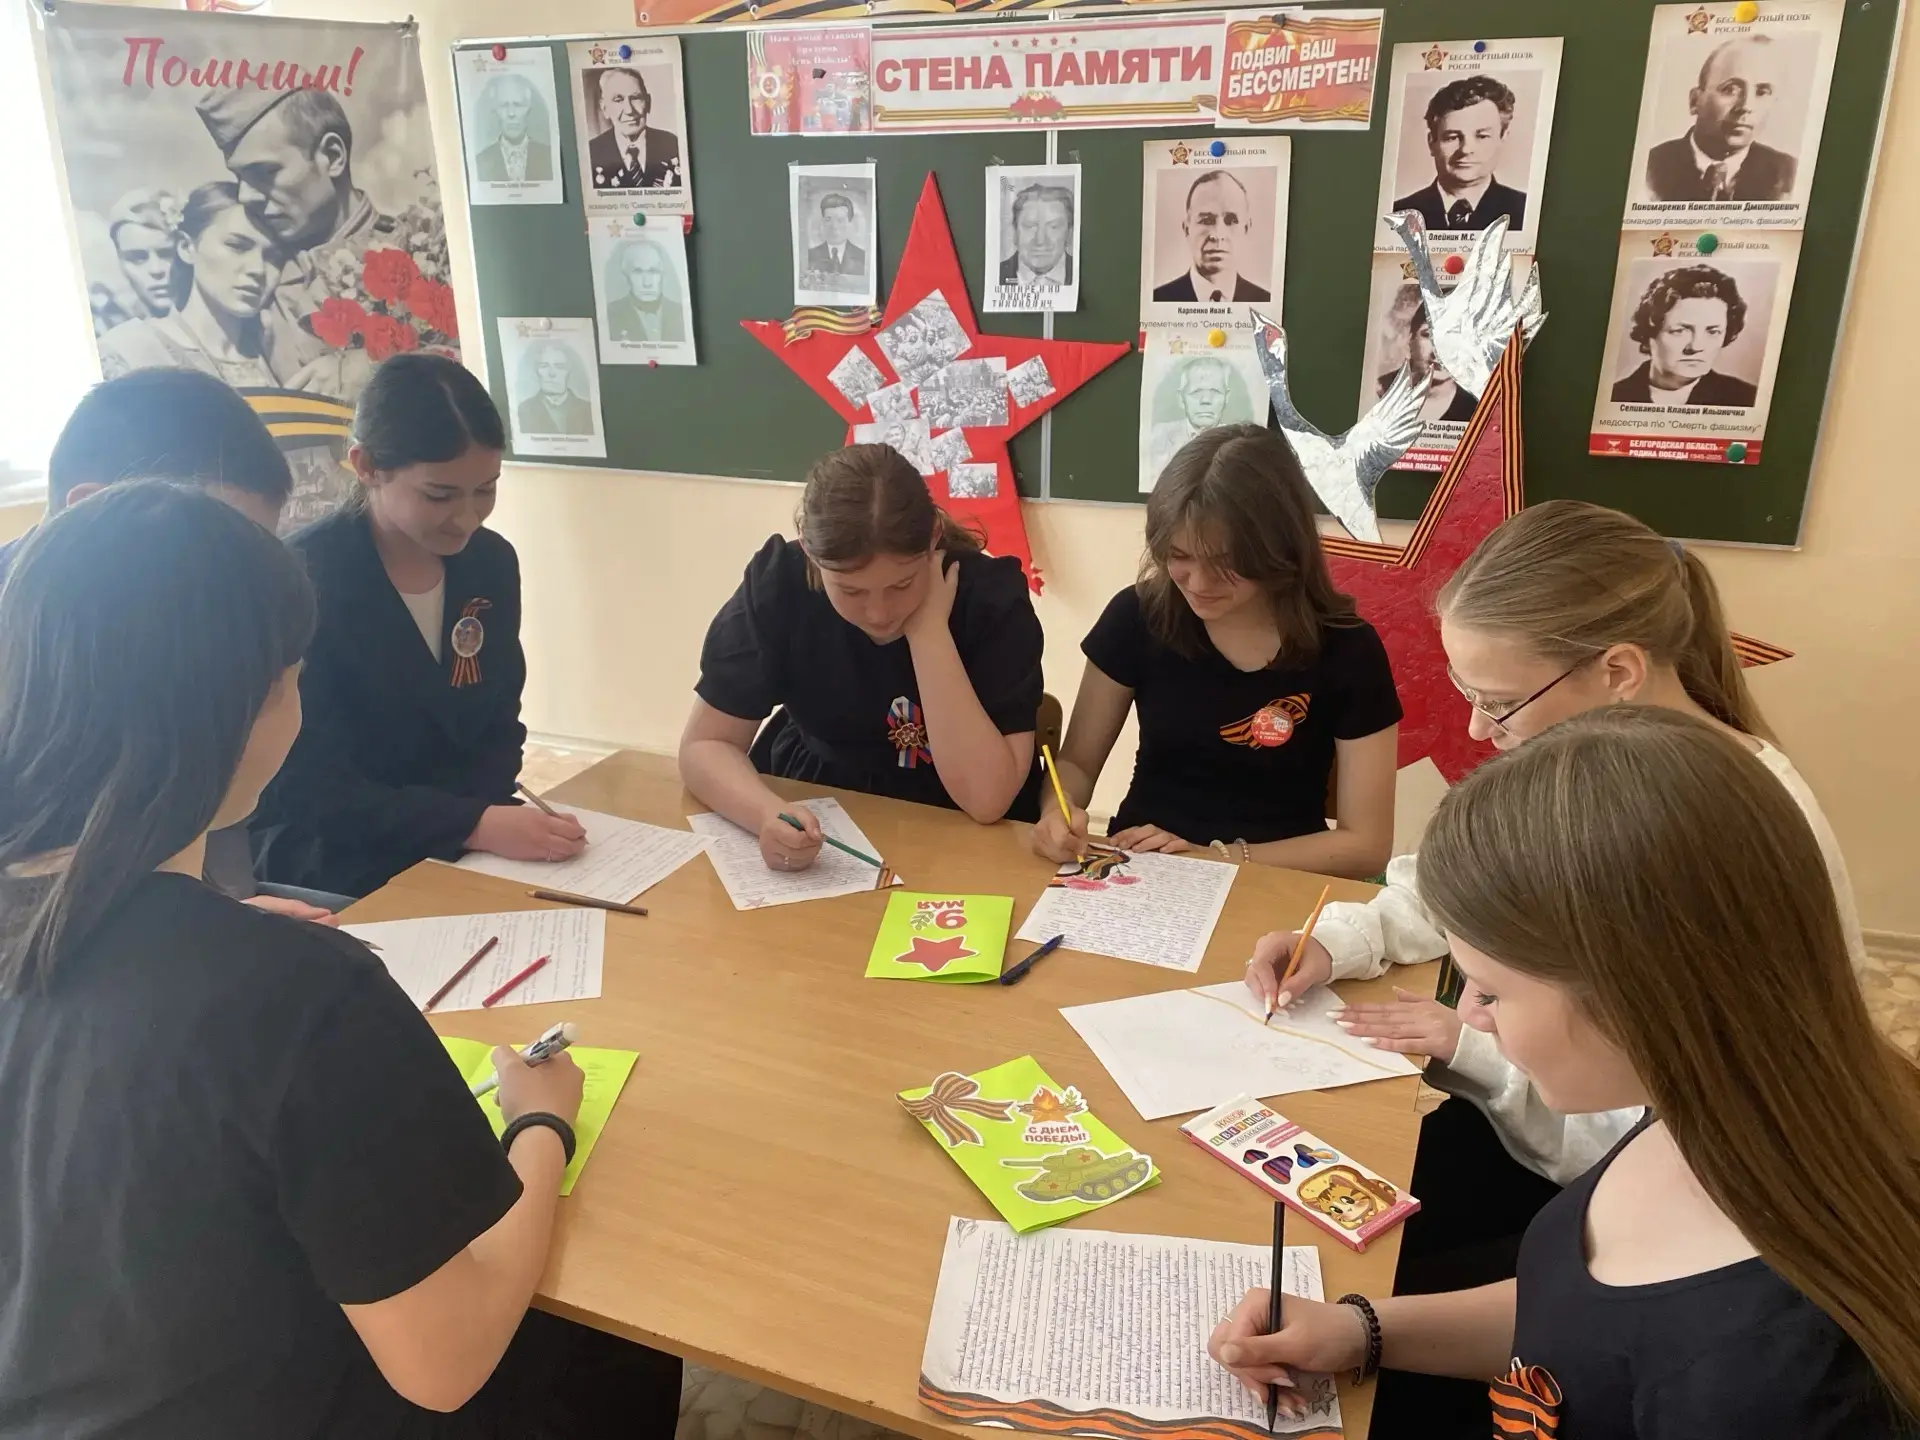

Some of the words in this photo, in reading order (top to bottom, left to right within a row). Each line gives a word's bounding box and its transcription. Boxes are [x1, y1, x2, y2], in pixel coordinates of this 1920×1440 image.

[1230, 44, 1296, 71] ПОДВИГ
[1300, 38, 1336, 62] ВАШ
[1449, 52, 1510, 60] БЕССМЕРТНЫЙ
[123, 37, 364, 97] Помним!
[876, 55, 1013, 92] СТЕНА
[1025, 45, 1212, 87] ПАМЯТИ
[1228, 56, 1371, 98] БЕССМЕРТЕН!
[1631, 203, 1687, 211] Пономаренко
[1688, 203, 1742, 211] Константин
[1743, 203, 1800, 212] Дмитриевич
[1429, 232, 1459, 241] Олейник
[1460, 233, 1477, 241] М.С.
[1178, 307, 1208, 315] Карпенко
[1139, 321, 1184, 329] пулеметчик
[1200, 320, 1232, 329] "Смерть
[1619, 404, 1666, 413] Селиванова
[1667, 406, 1700, 415] Клавдия
[1428, 422, 1466, 432] Серафима
[1599, 419, 1649, 428] медсестра
[1668, 420, 1708, 431] "Смерть
[1710, 423, 1762, 434] фашизму"
[1629, 440, 1685, 449] БЕЛГОРОДСКАЯ
[1686, 442, 1718, 451] ОБЛАСТЬ
[1629, 450, 1657, 458] РОДИНА
[1658, 451, 1689, 459] ПОБЕДЫ
[1415, 462, 1442, 471] ПОБЕДЫ
[917, 899, 965, 909] МАЯ
[935, 909, 967, 929] 9
[1028, 1126, 1037, 1134] С
[1040, 1125, 1080, 1135] ДНЕМ
[1209, 1109, 1274, 1146] ЦВЕТНЫХ
[1025, 1132, 1087, 1144] ПОБЕДЫ!
